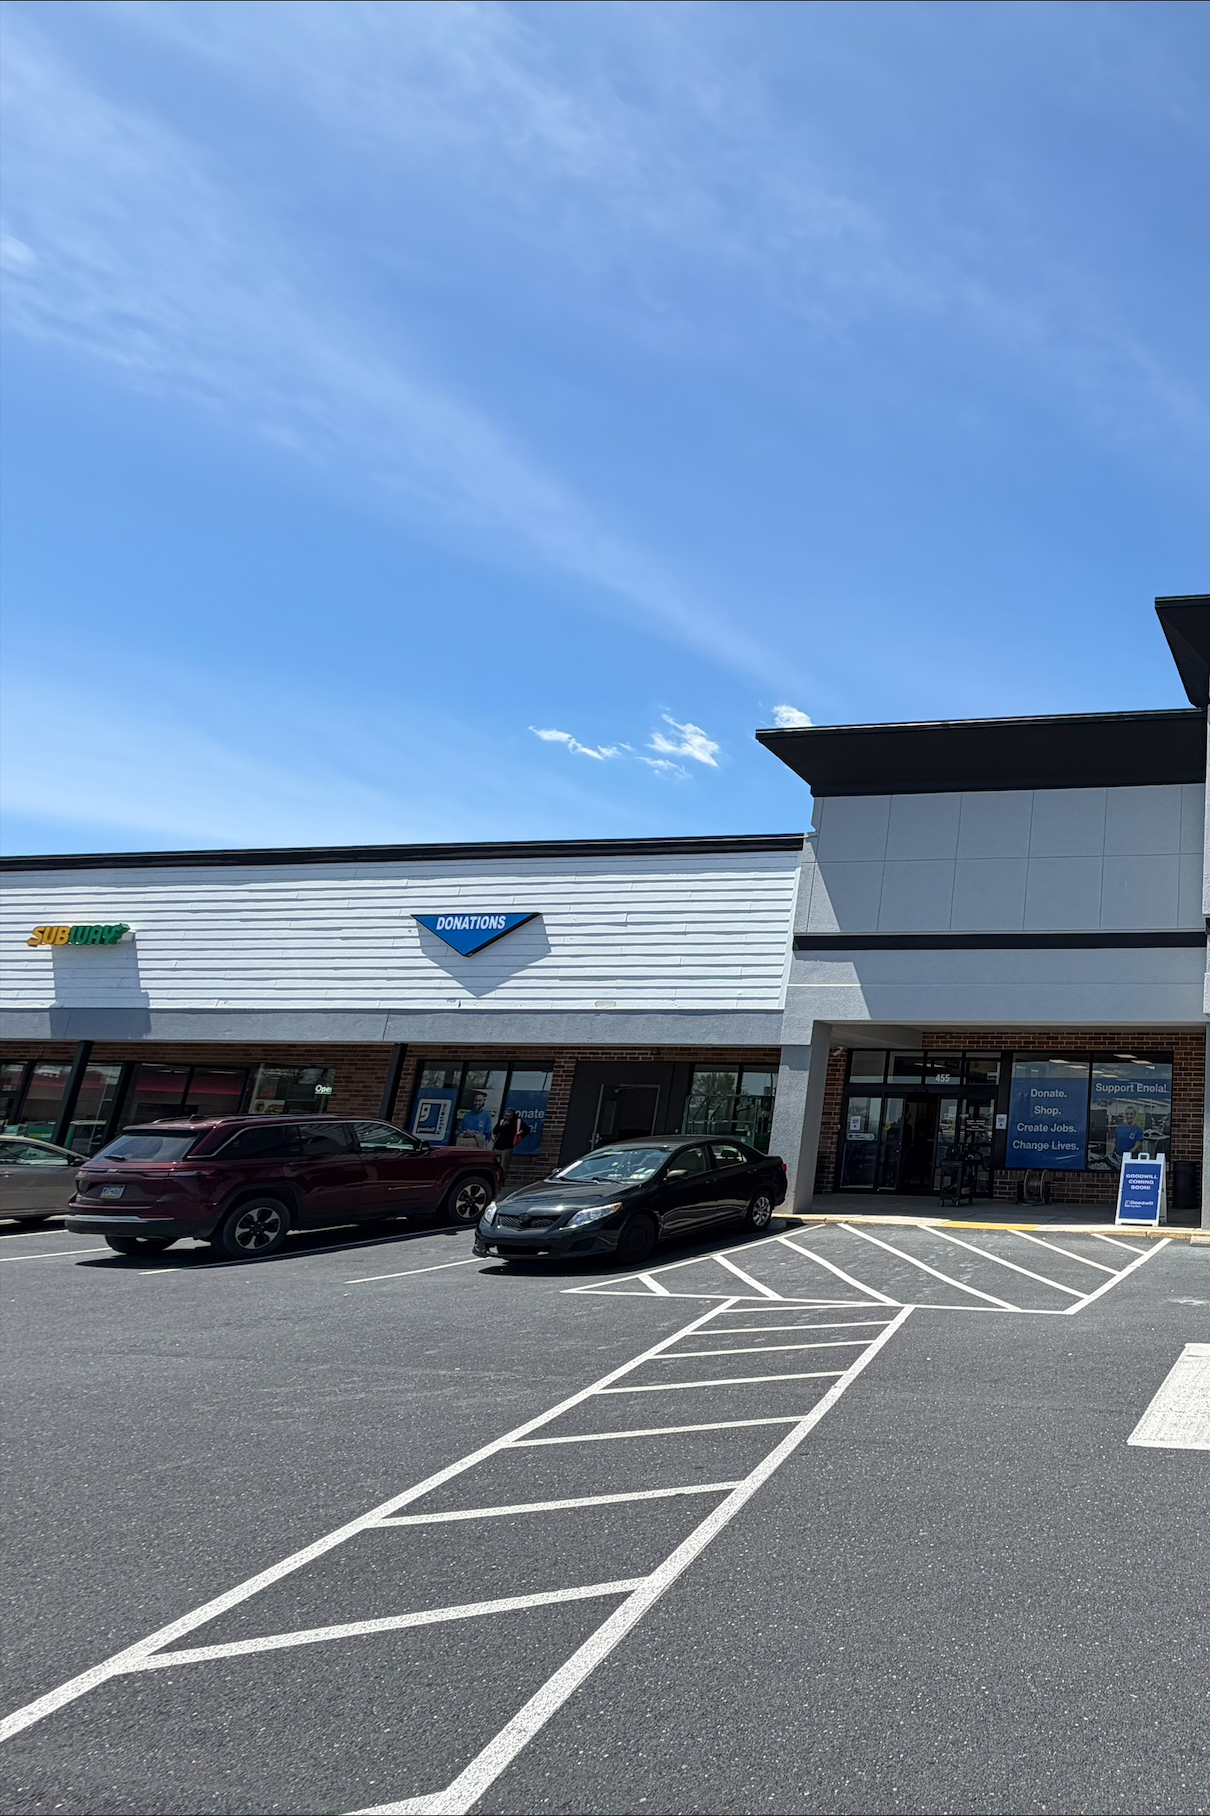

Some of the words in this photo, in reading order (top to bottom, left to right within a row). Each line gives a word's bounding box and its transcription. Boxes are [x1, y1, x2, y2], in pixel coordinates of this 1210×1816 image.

[436, 915, 507, 930] DONATIONS
[26, 923, 130, 947] SUBWAY
[935, 1073, 950, 1083] 455
[1030, 1088, 1067, 1098] Donate.
[1095, 1083, 1134, 1094] Support
[1137, 1083, 1168, 1093] Enola!
[1034, 1106, 1061, 1117] Shop.
[1016, 1123, 1048, 1133] Create
[1051, 1123, 1077, 1133] Jobs.
[1012, 1140, 1049, 1151] Change
[1052, 1140, 1080, 1151] Lives.
